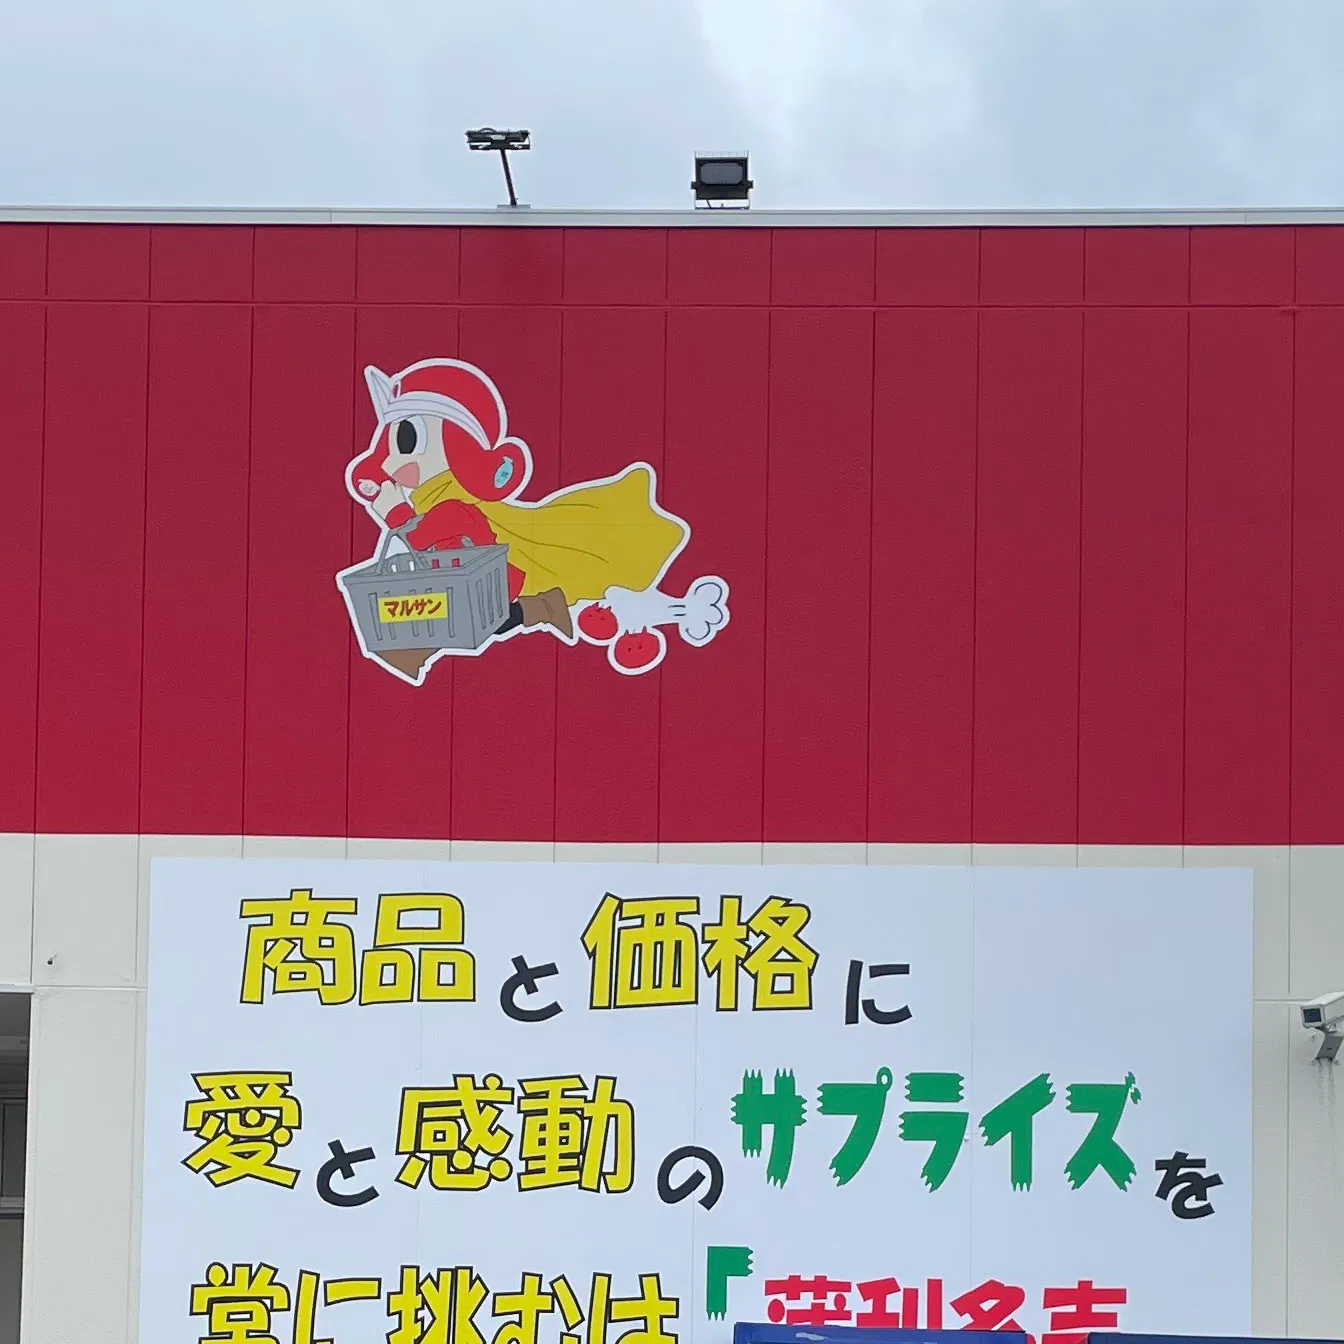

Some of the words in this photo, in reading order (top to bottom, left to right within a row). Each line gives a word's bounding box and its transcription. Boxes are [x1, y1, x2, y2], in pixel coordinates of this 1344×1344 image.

[384, 598, 442, 617] マルサン
[240, 889, 912, 1024] 商品と価格に
[181, 1067, 1223, 1219] 愛と感動のサプライズを
